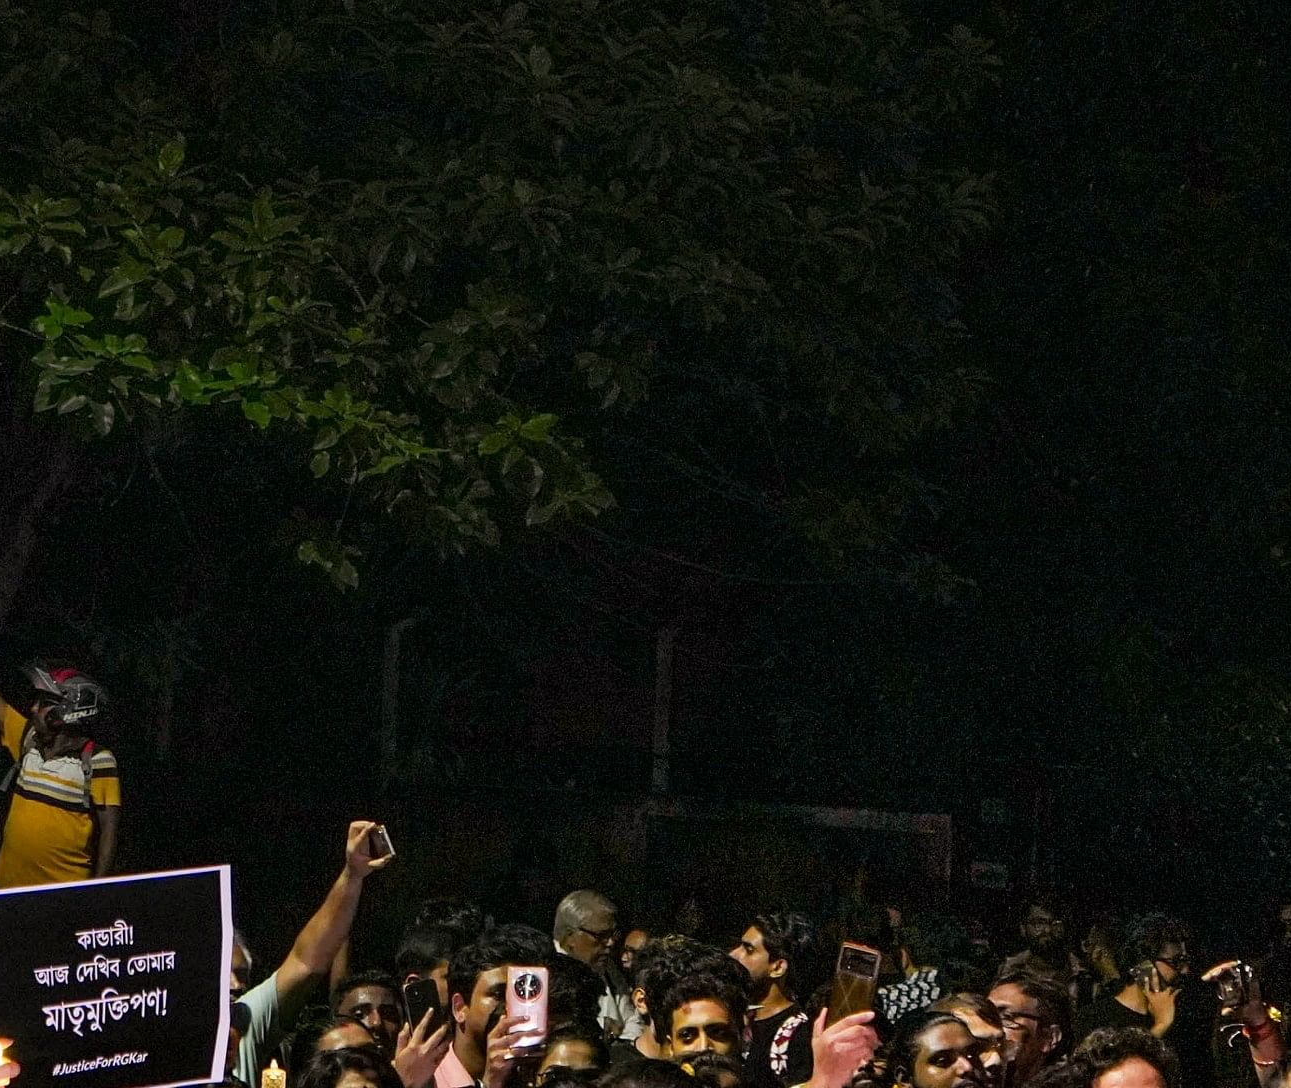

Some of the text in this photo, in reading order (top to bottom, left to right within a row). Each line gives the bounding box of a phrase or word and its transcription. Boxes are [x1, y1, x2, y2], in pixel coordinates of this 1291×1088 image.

[34, 950, 176, 988] আজ দেখিব তোমার
[41, 987, 168, 1038] মাতৃমুক্তিপণ!
[52, 1050, 149, 1077] #JusticeForRGKar
